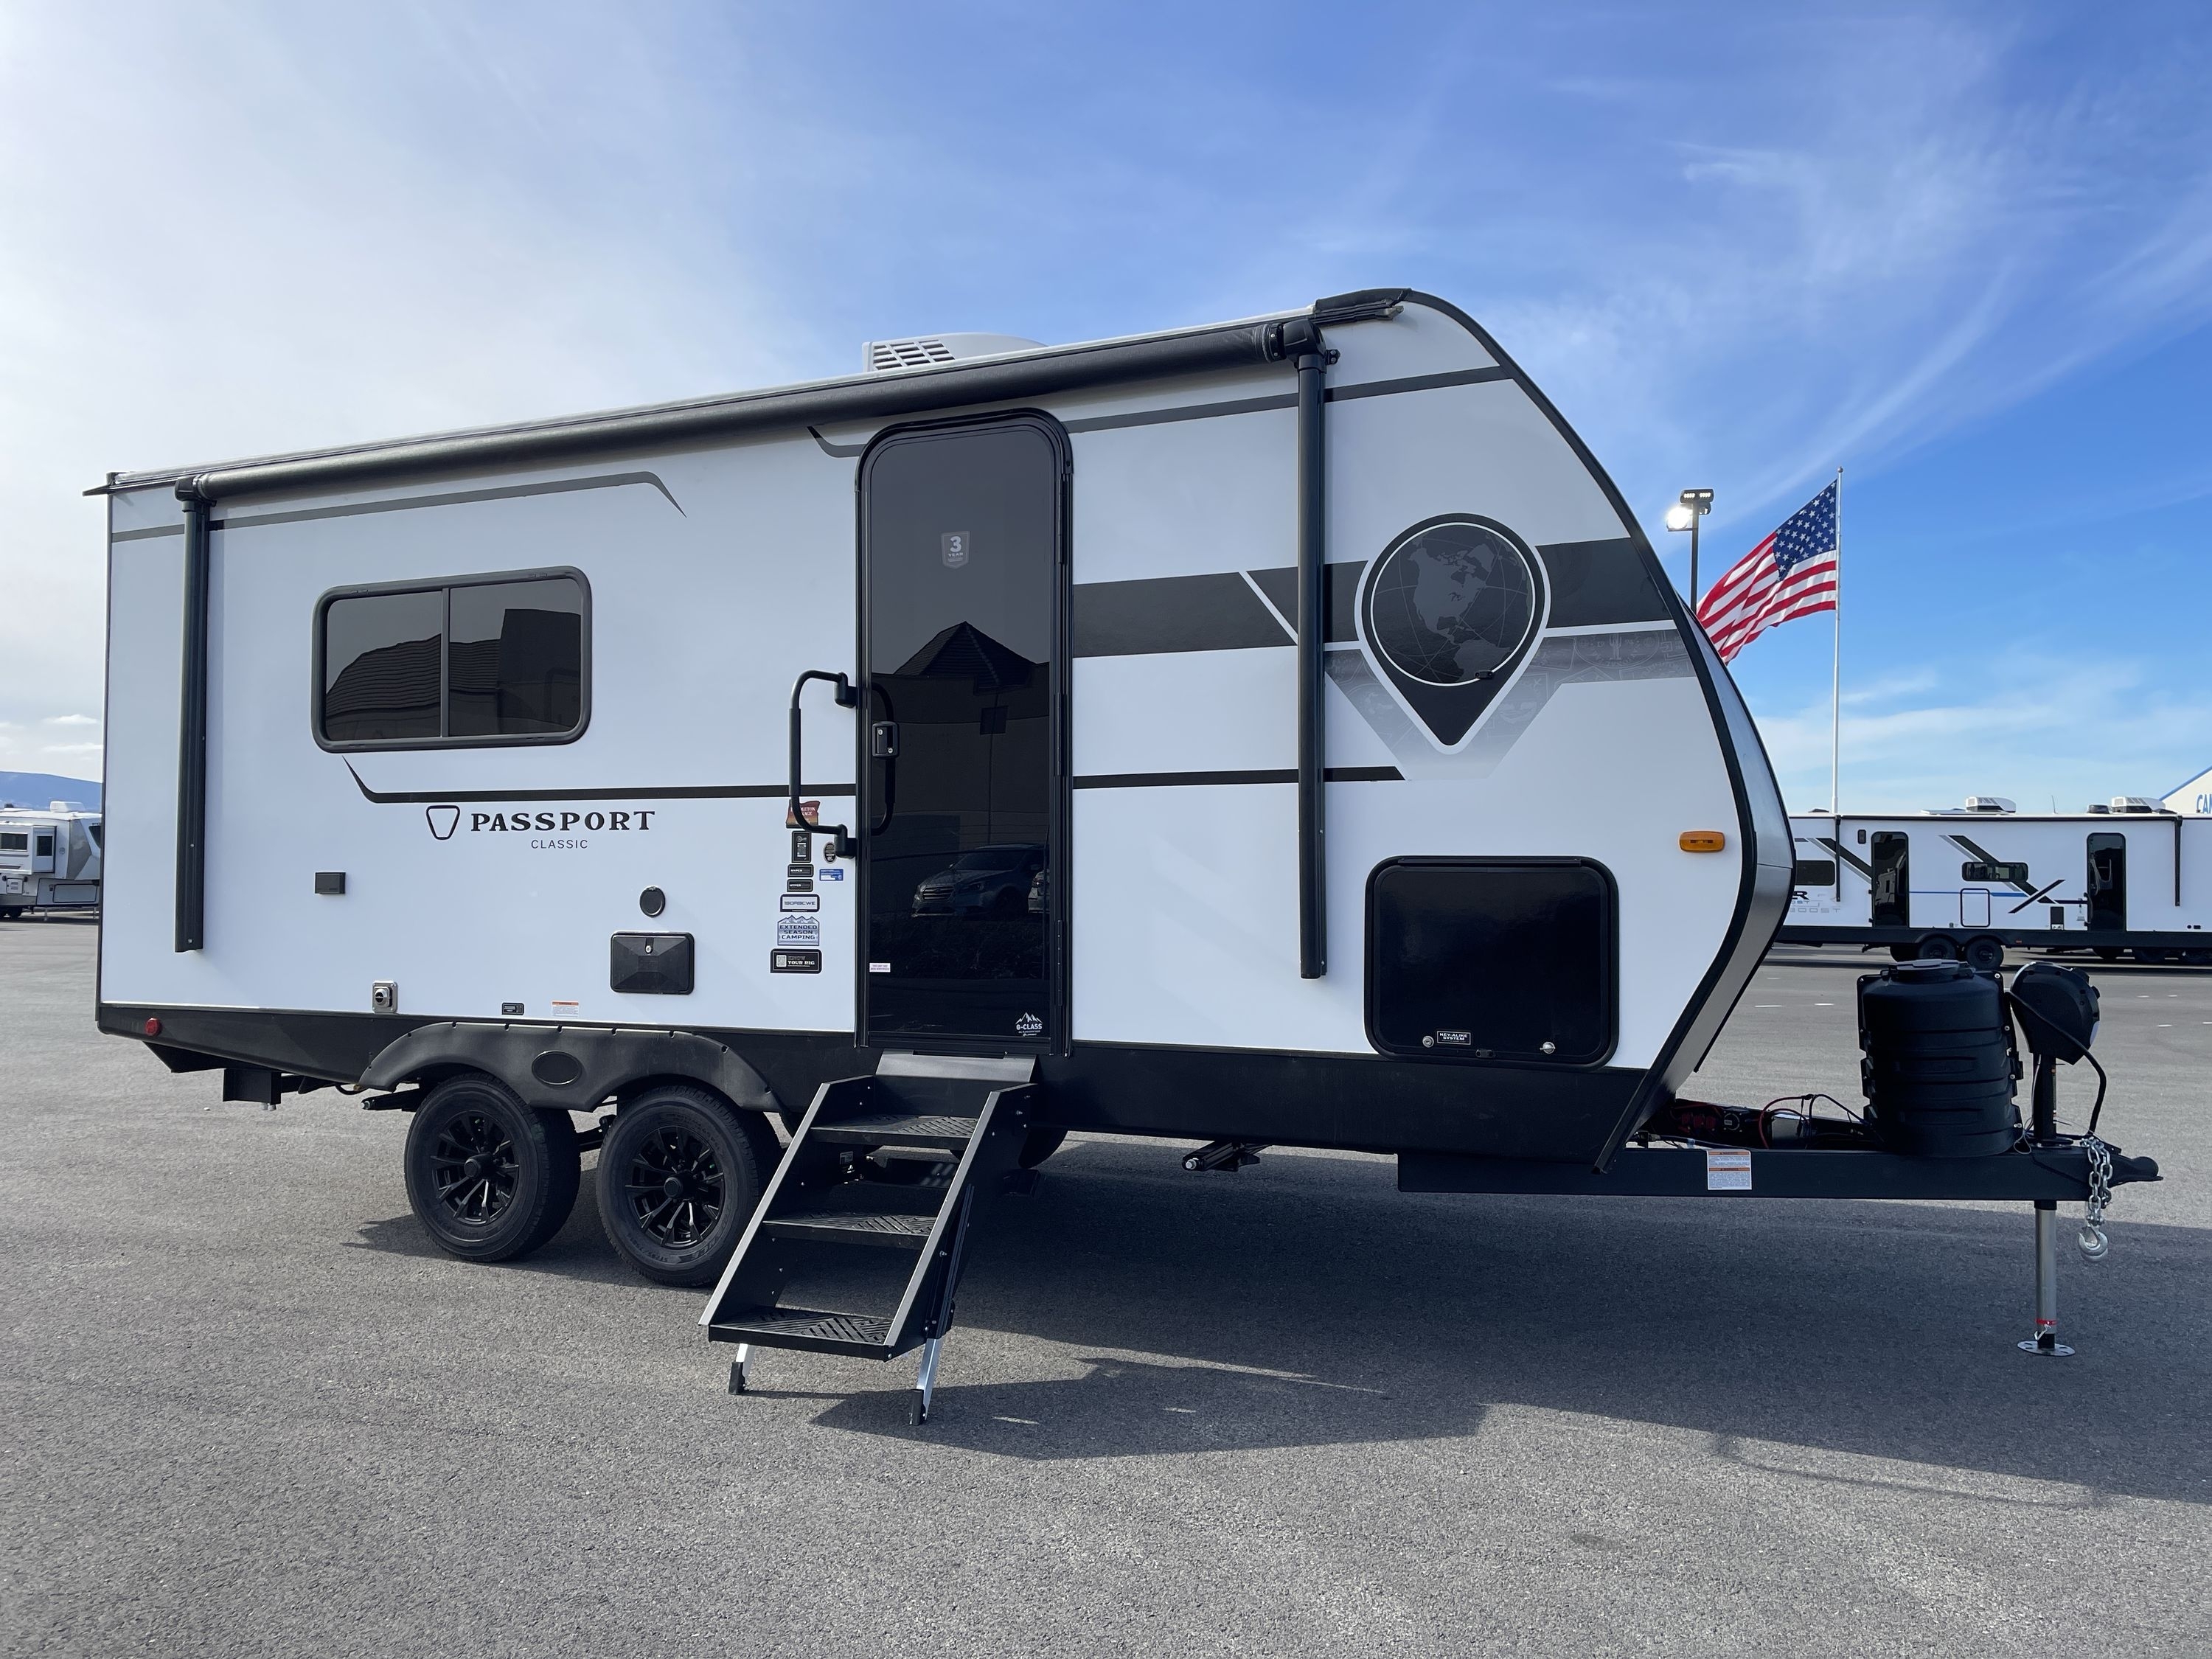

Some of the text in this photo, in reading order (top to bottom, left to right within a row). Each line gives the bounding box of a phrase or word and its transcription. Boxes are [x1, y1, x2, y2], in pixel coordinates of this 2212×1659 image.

[950, 535, 961, 552] 3
[2196, 794, 2212, 814] CA
[470, 811, 655, 831] PASSPORT
[531, 840, 588, 849] CLASSIC
